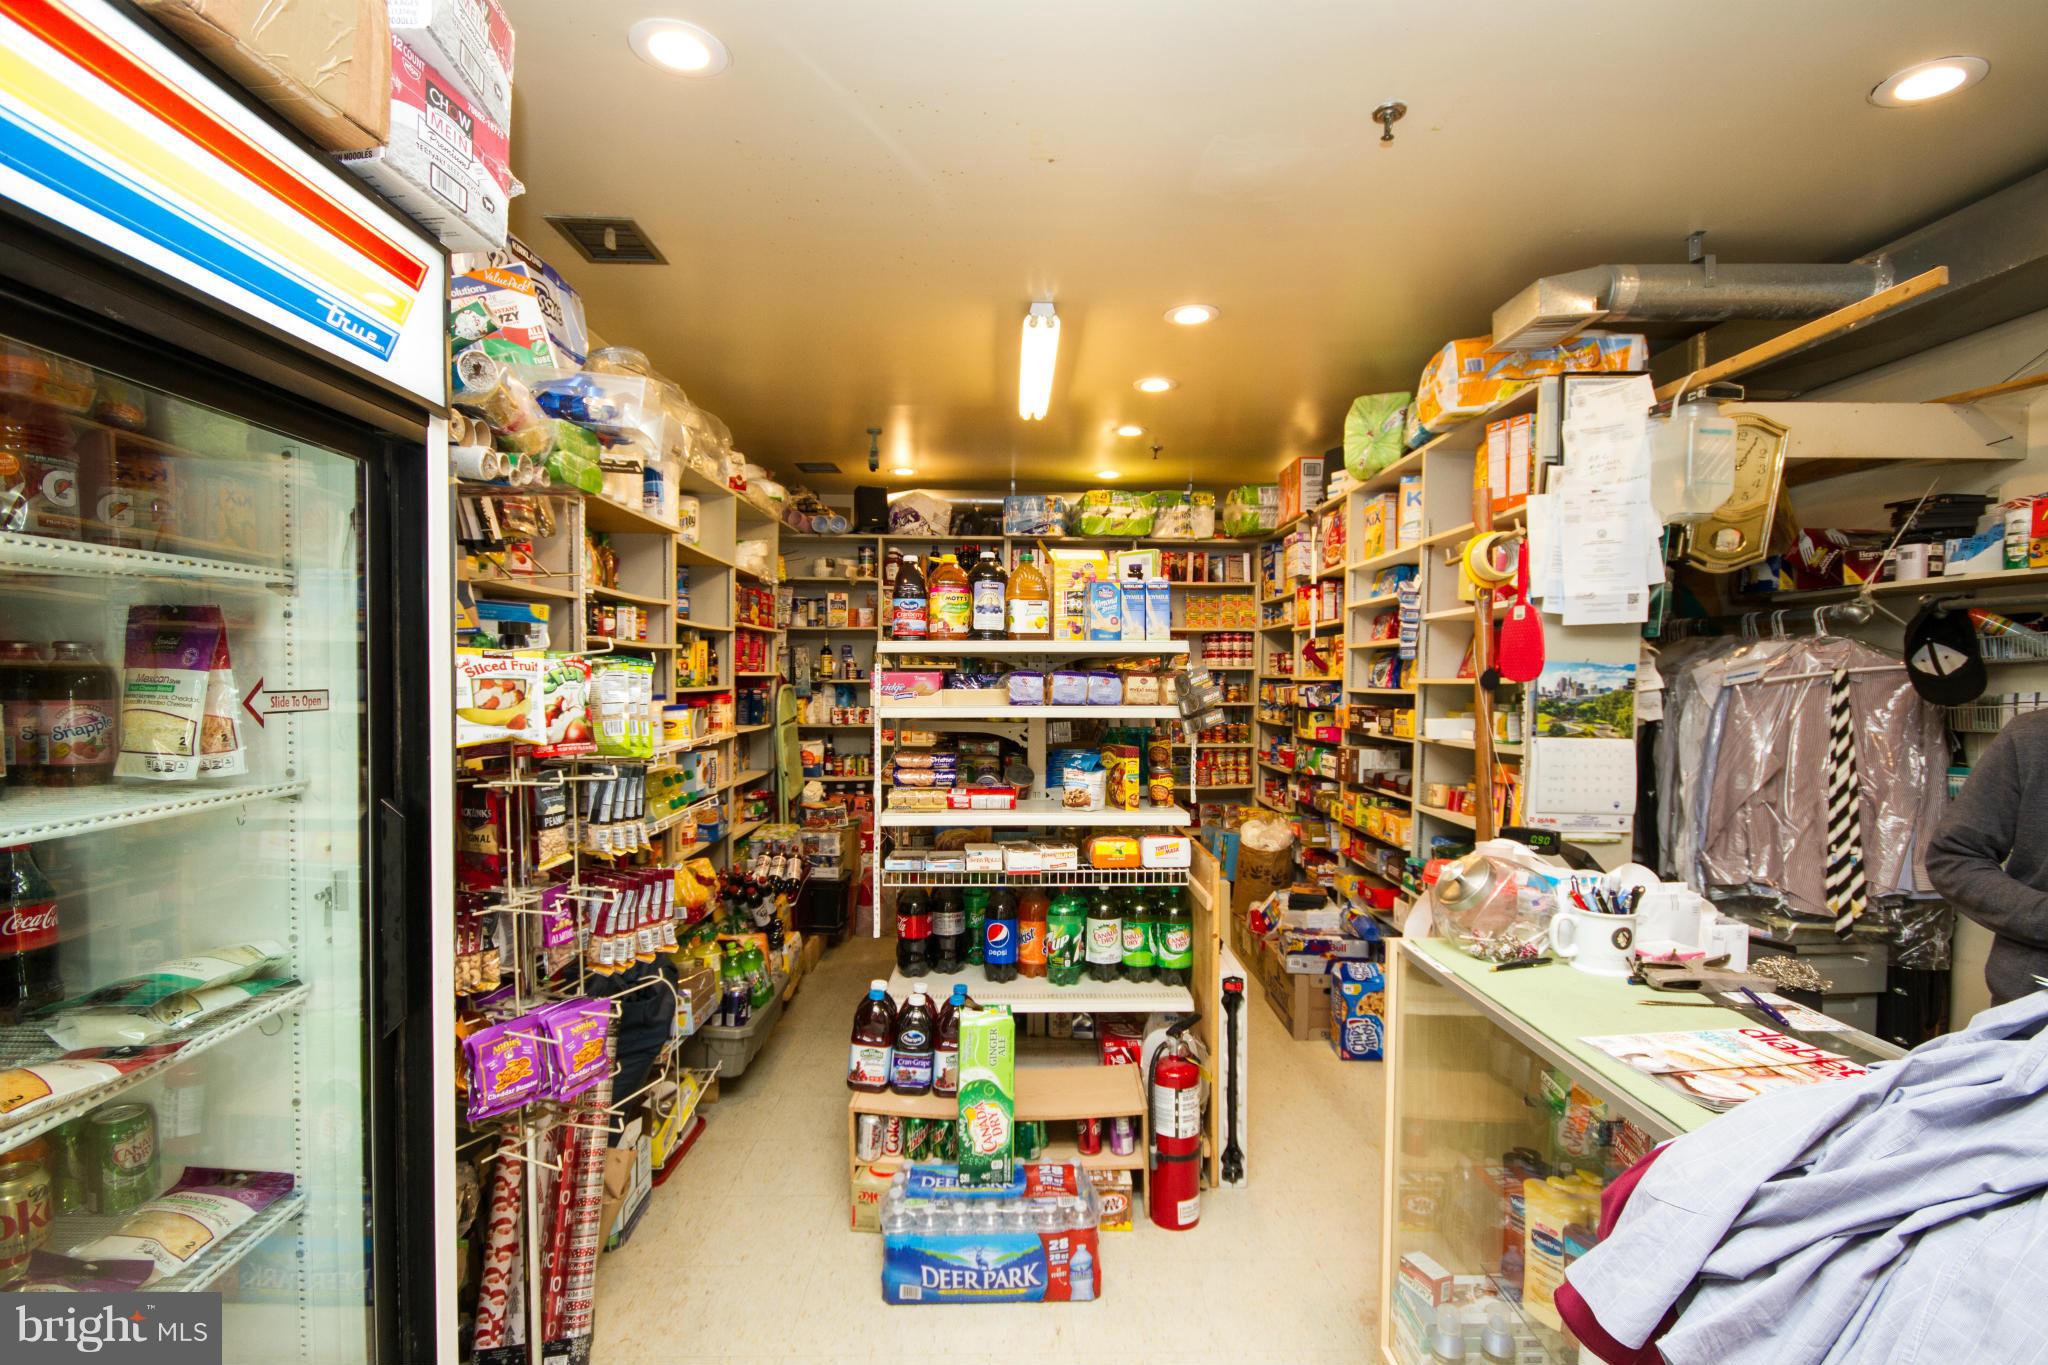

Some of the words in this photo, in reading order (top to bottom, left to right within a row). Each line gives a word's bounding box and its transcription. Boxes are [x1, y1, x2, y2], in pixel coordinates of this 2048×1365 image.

[391, 34, 404, 51] 12
[403, 45, 425, 72] COUNT
[429, 87, 473, 132] CHOW
[430, 112, 469, 146] MEIN
[451, 284, 487, 298] olutions
[464, 660, 507, 678] Sliced
[270, 695, 290, 708] Slide
[291, 695, 300, 707] To
[302, 695, 322, 708] Open
[52, 717, 113, 741] Snapple
[1330, 942, 1347, 952] Bull
[989, 1028, 998, 1067] GINGER
[998, 1036, 1006, 1057] ALE
[1350, 1026, 1366, 1053] Chips
[1737, 1028, 1867, 1078] diabet
[487, 1088, 515, 1101] Cheddar
[975, 1101, 998, 1153] CANADA
[989, 1112, 1003, 1136] DRY
[921, 1176, 959, 1189] DEE
[921, 1264, 982, 1290] DEER
[983, 1261, 1042, 1290] PARK
